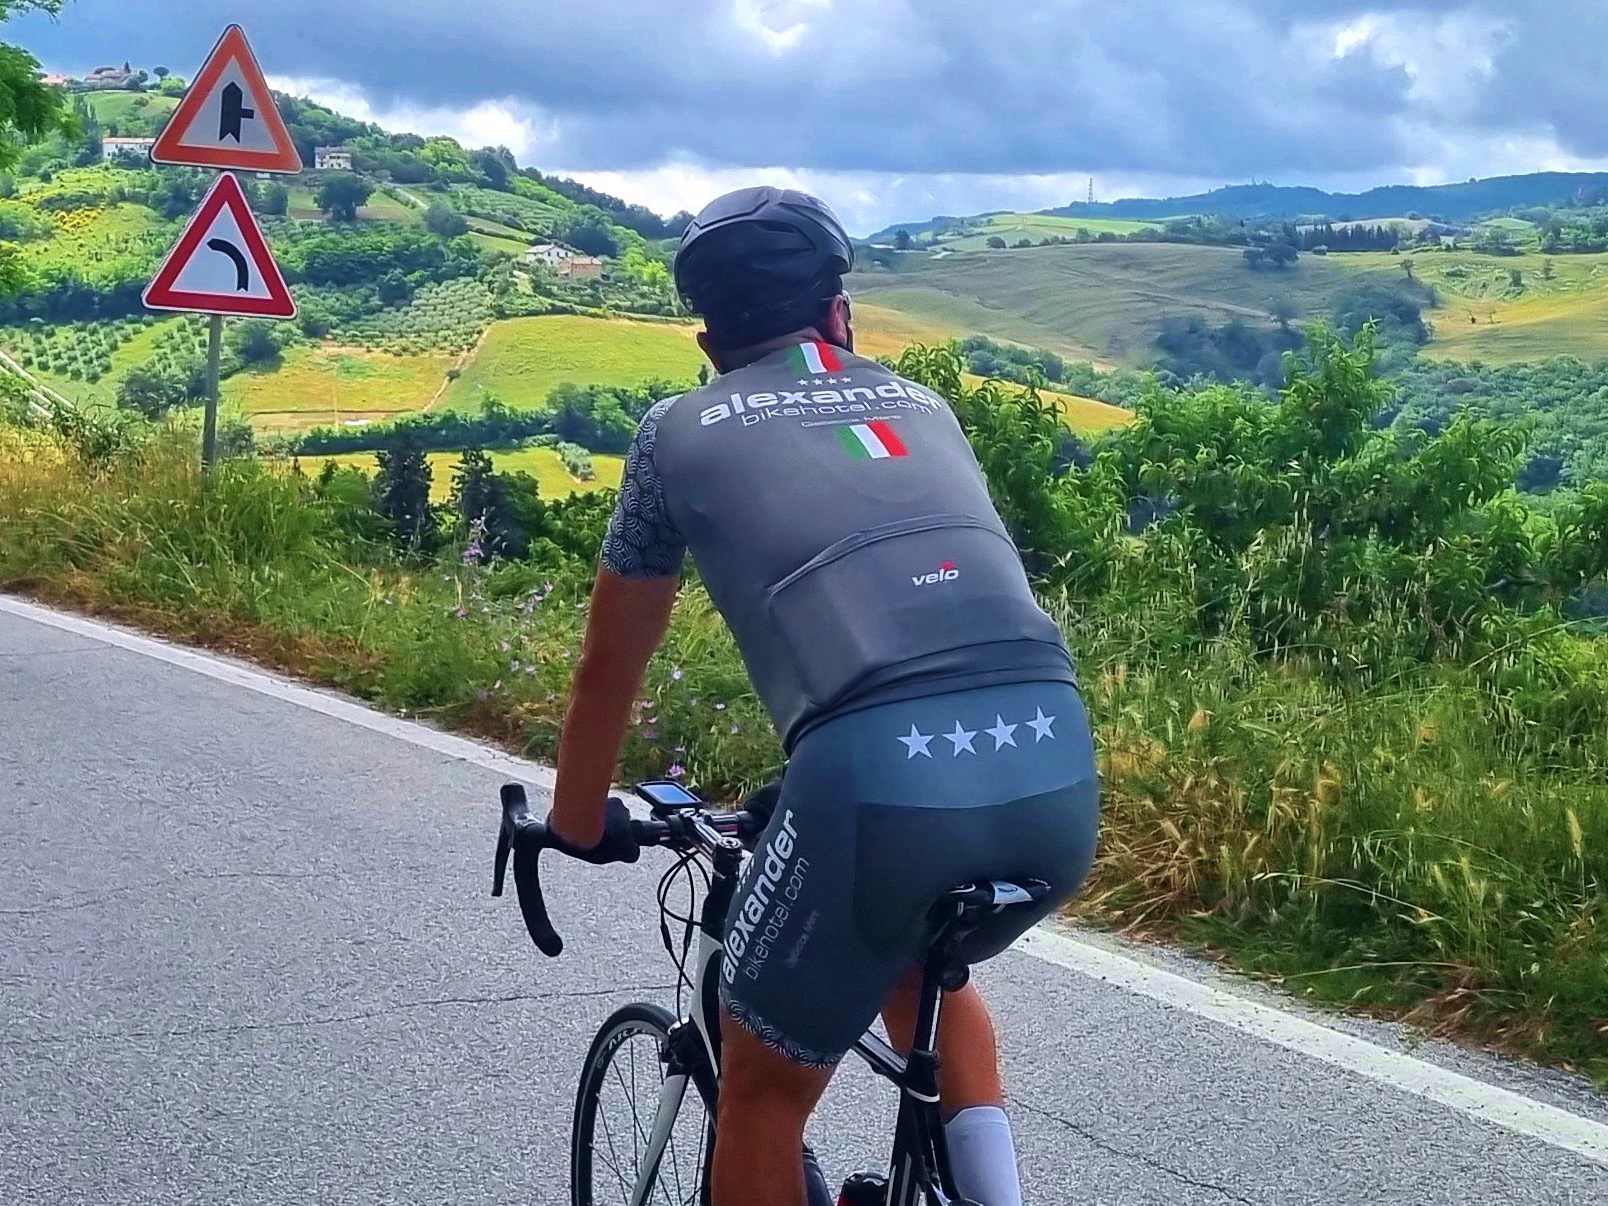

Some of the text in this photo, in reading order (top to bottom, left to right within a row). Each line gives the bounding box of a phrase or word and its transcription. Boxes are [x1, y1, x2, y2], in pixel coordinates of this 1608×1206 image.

[700, 382, 942, 426] alexander
[742, 400, 932, 426] bikehotel.com
[912, 567, 959, 587] velo
[723, 808, 798, 985] alexander
[745, 856, 810, 981] bikehotel.com
